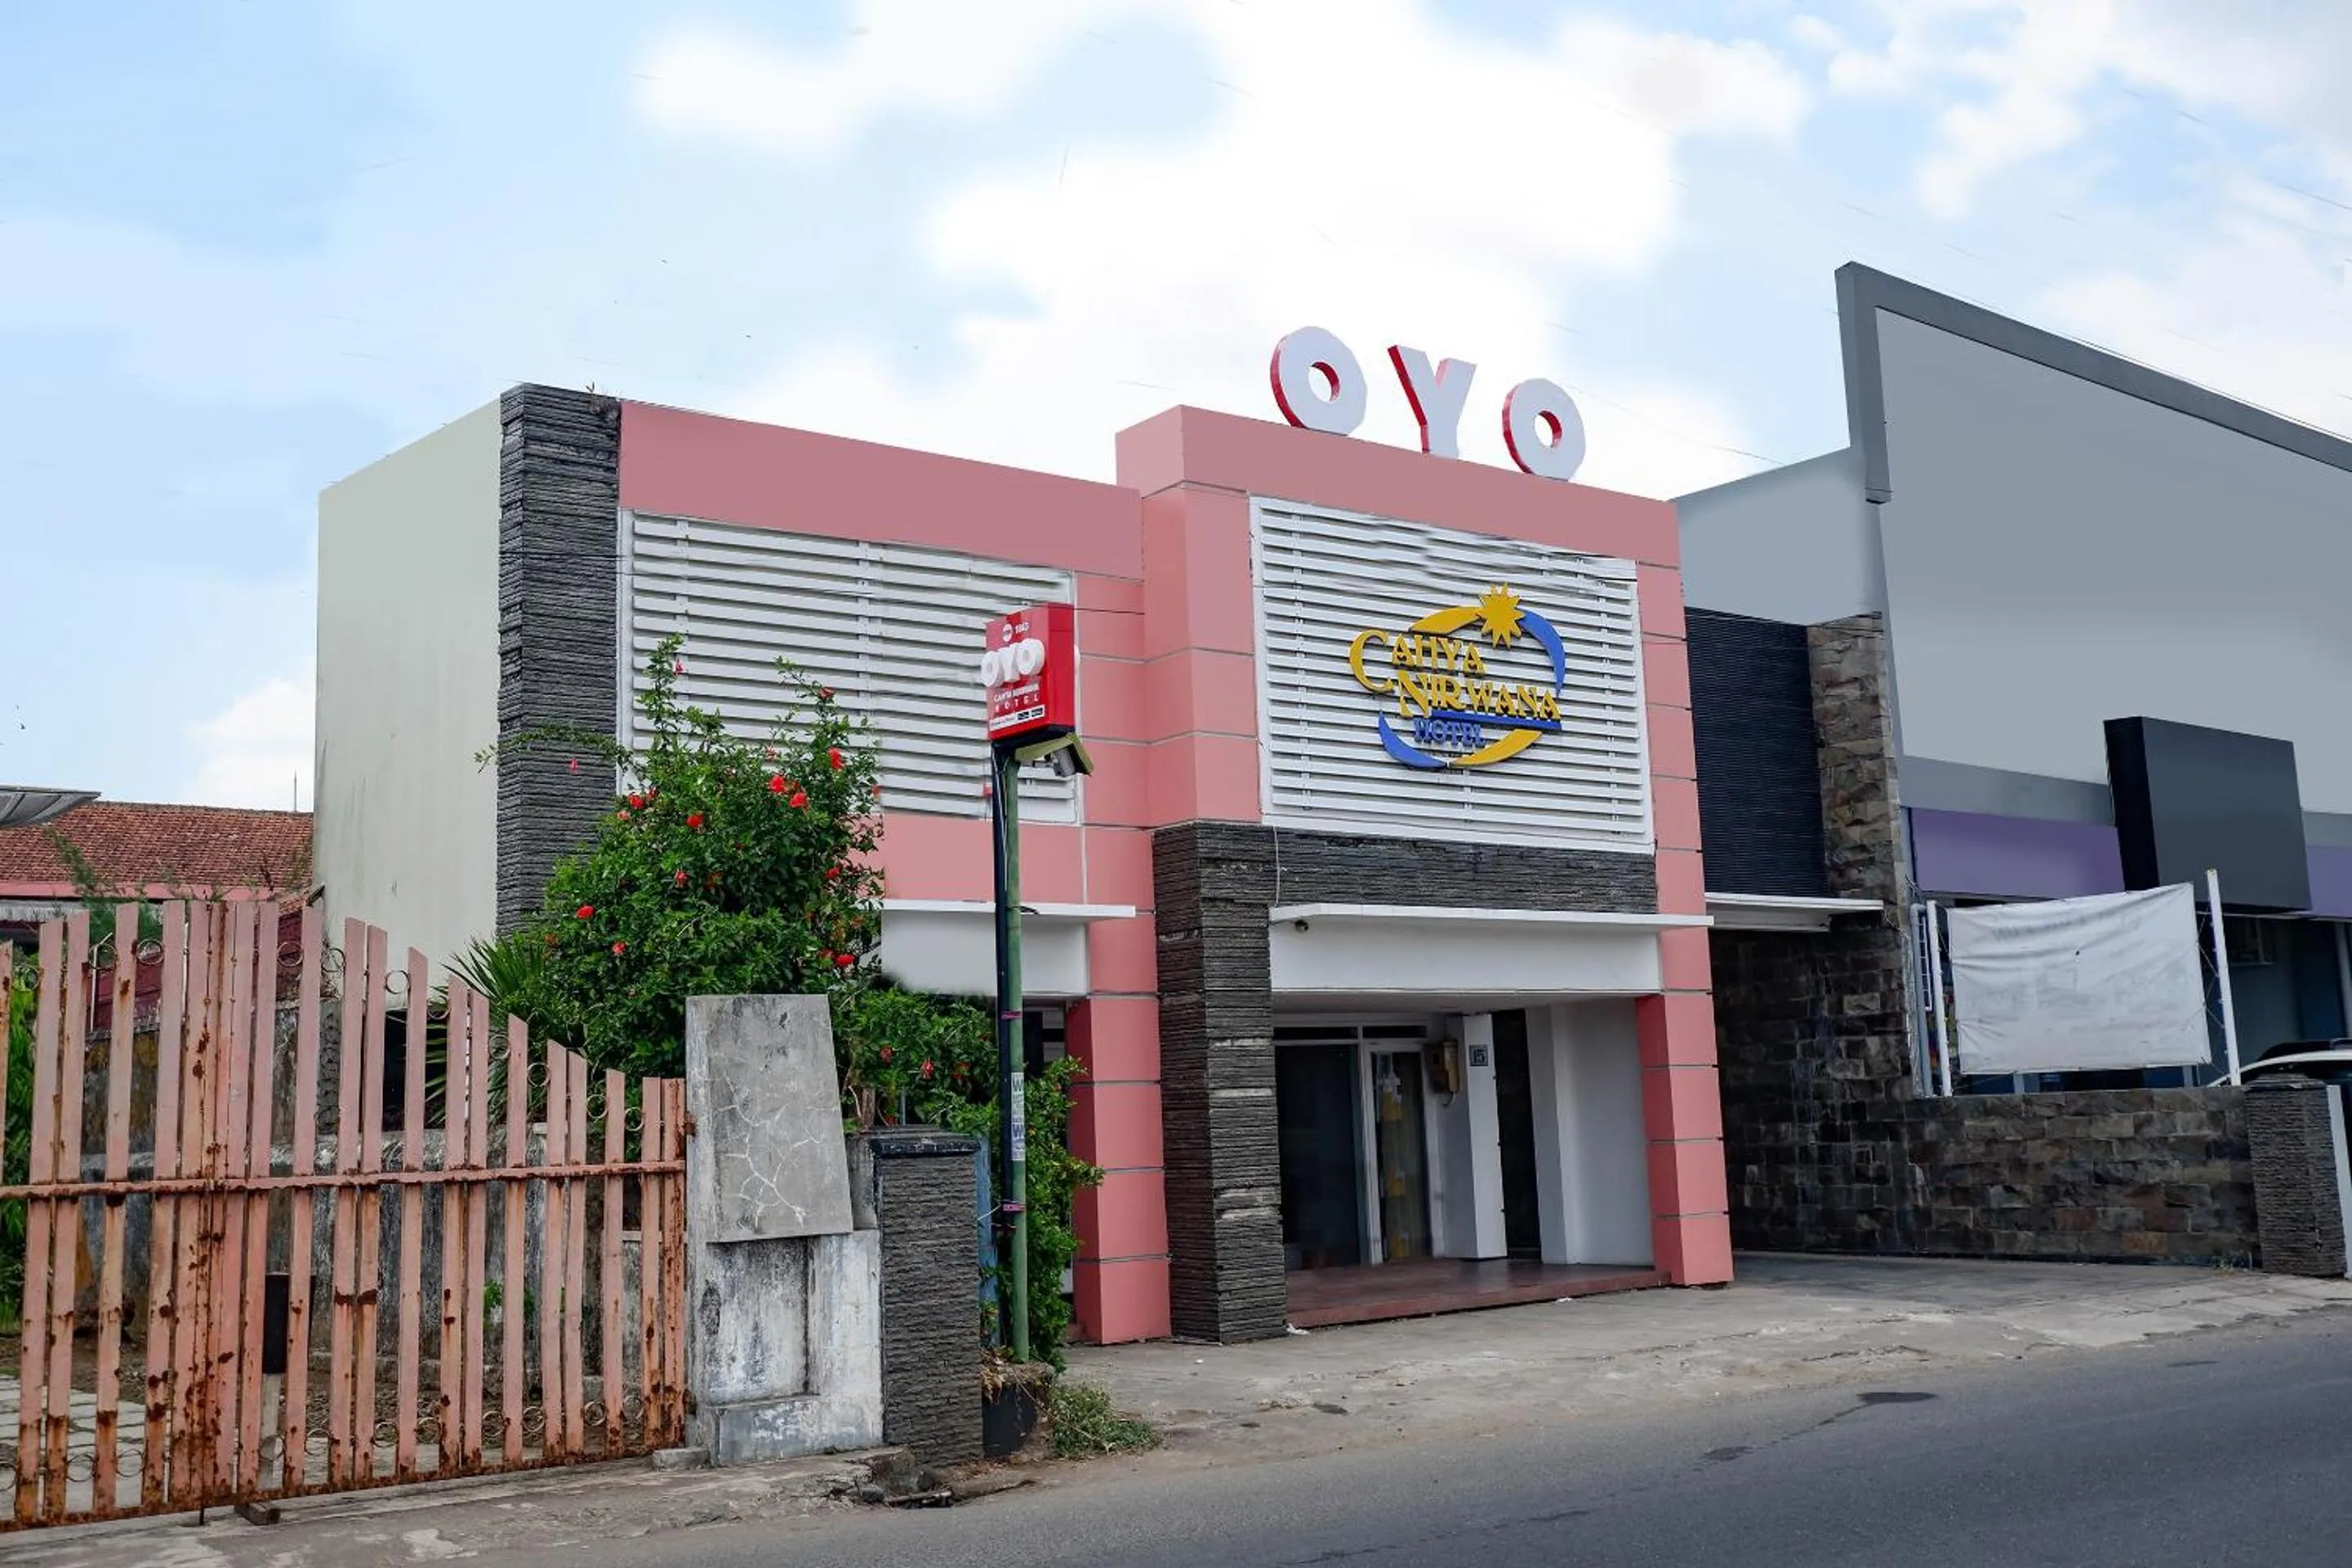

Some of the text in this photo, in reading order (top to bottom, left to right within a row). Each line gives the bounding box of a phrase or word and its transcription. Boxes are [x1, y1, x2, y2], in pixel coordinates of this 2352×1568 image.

[1270, 326, 1586, 482] OYO
[981, 638, 1045, 687] OYO
[1348, 629, 1487, 693] CAHYA
[1396, 669, 1562, 720] NIRWANA
[1414, 718, 1487, 748] HOTEL
